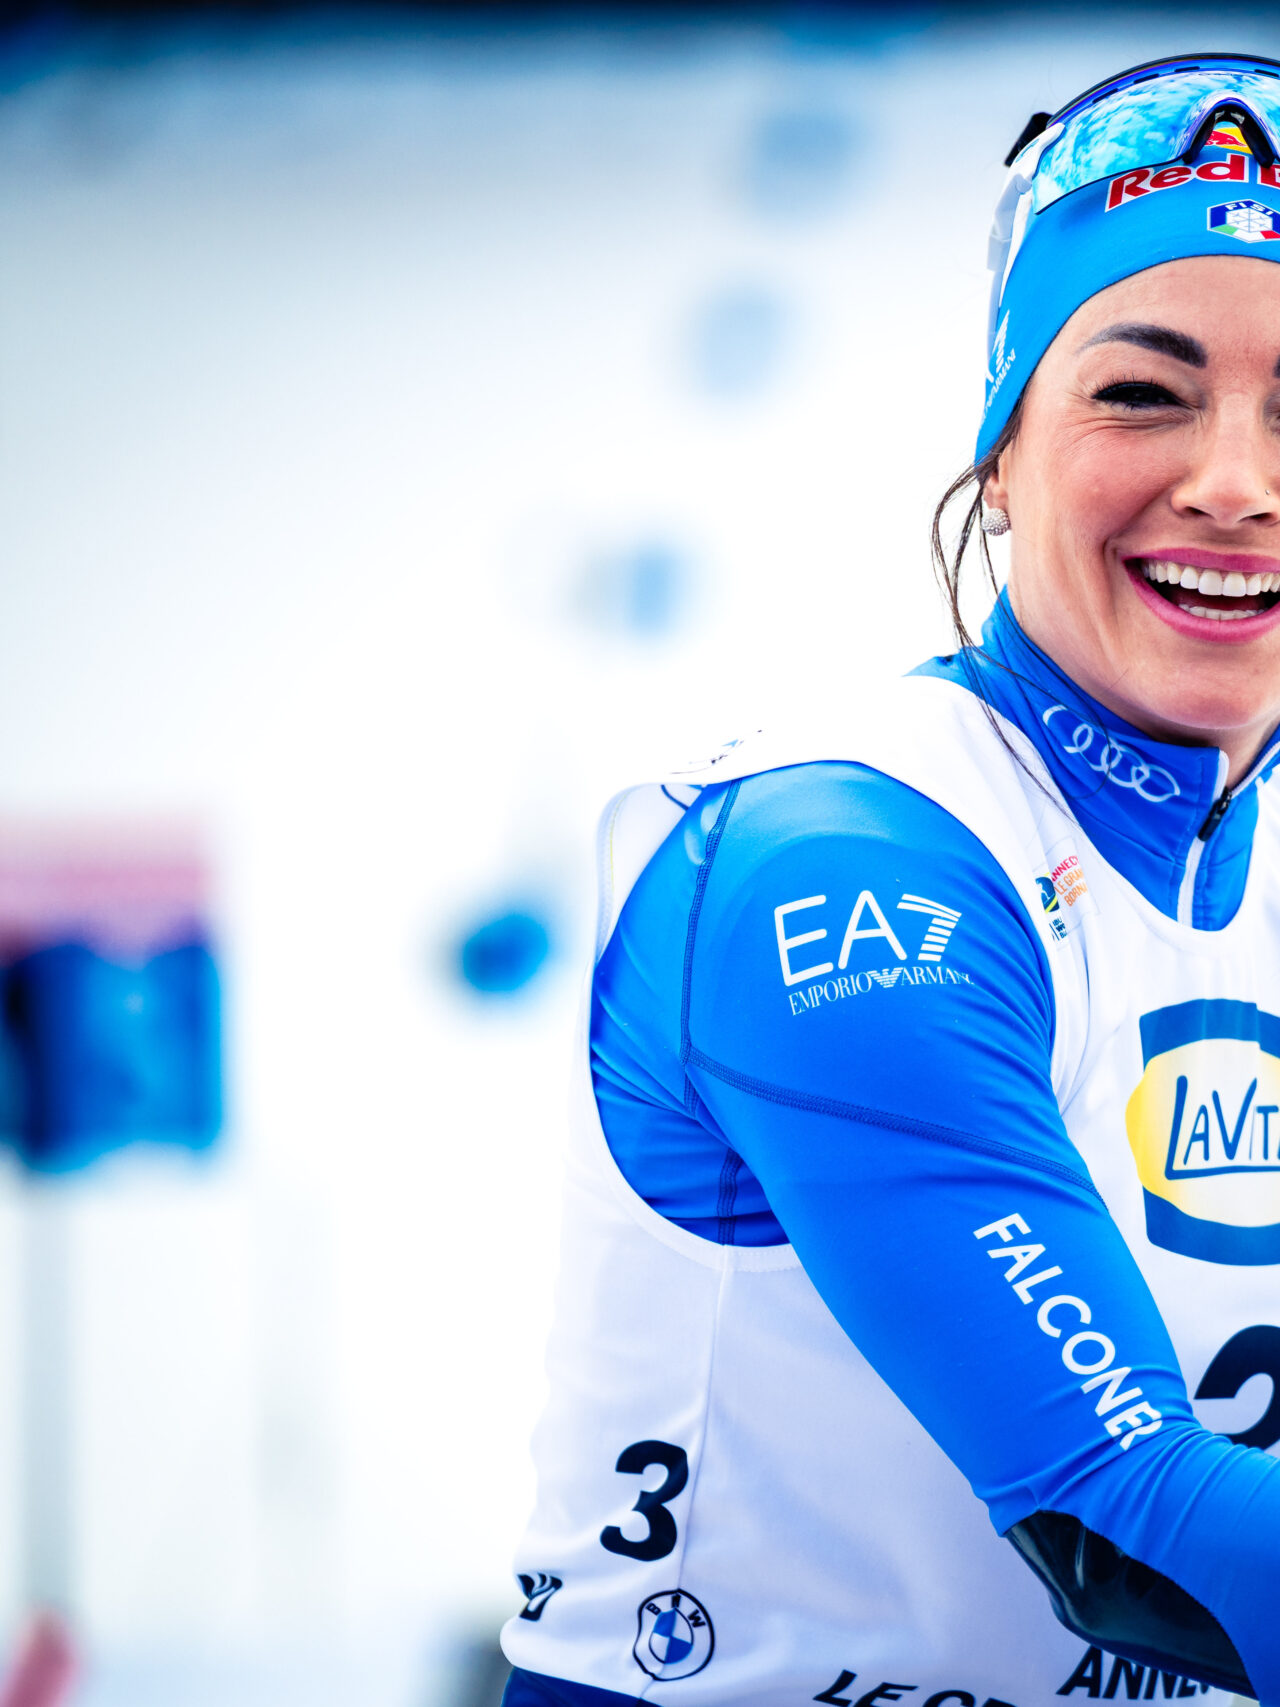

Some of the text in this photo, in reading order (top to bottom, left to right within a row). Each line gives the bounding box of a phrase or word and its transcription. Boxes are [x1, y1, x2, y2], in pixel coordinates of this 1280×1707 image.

[1106, 153, 1248, 212] Red
[1225, 202, 1274, 216] FISI
[774, 889, 963, 987] EA7
[788, 965, 974, 1016] EMPORIO ARMAN
[600, 1439, 689, 1562] 3
[646, 1593, 706, 1628] BMW
[1056, 1643, 1209, 1700] ANN
